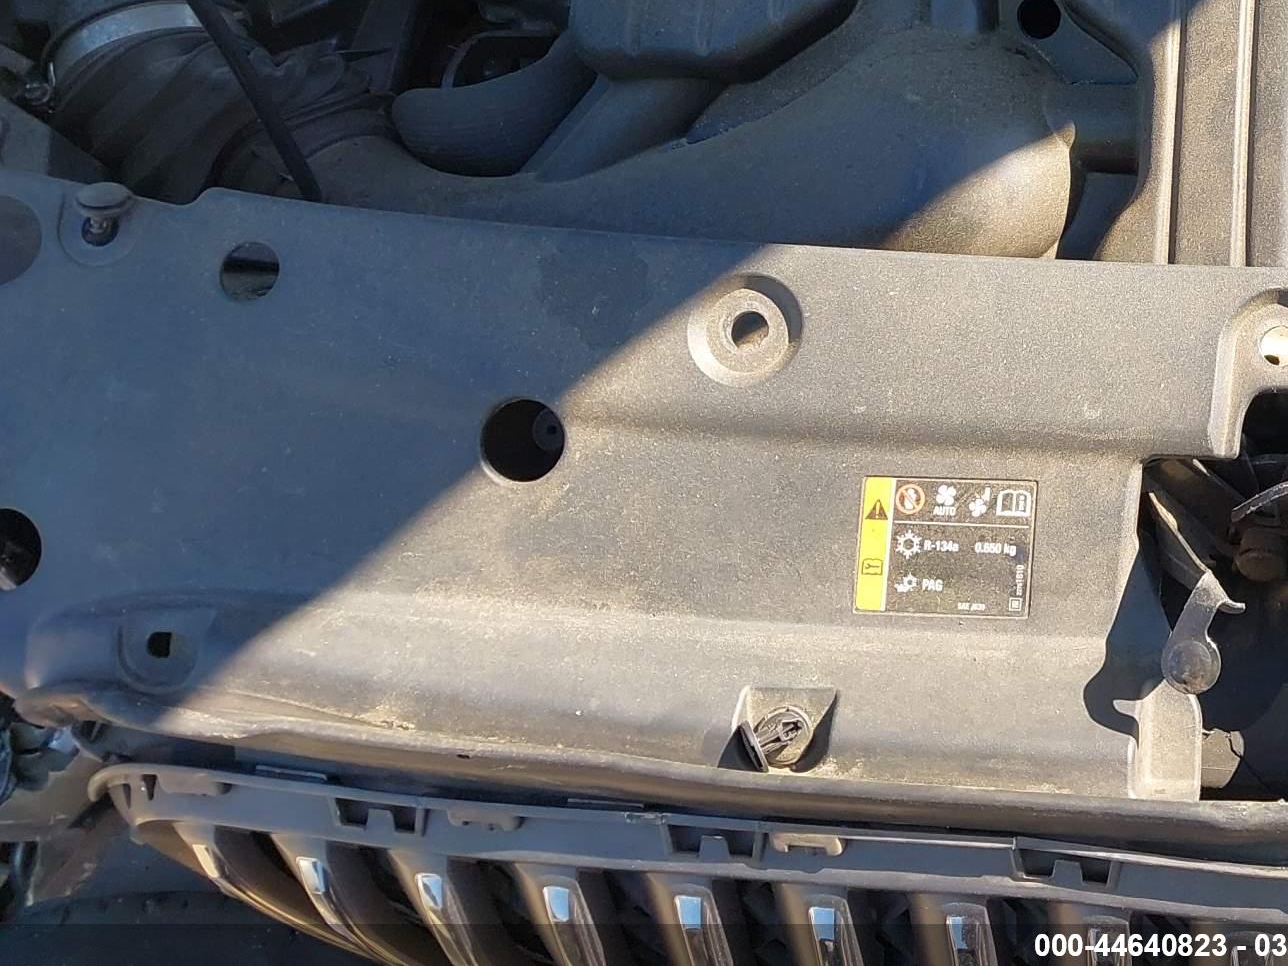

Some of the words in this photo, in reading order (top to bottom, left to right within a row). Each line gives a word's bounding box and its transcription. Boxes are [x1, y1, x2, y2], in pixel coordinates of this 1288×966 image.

[933, 506, 956, 516] AUTO
[924, 540, 959, 552] R-134a
[1003, 542, 1017, 557] kg
[922, 579, 943, 591] PAG
